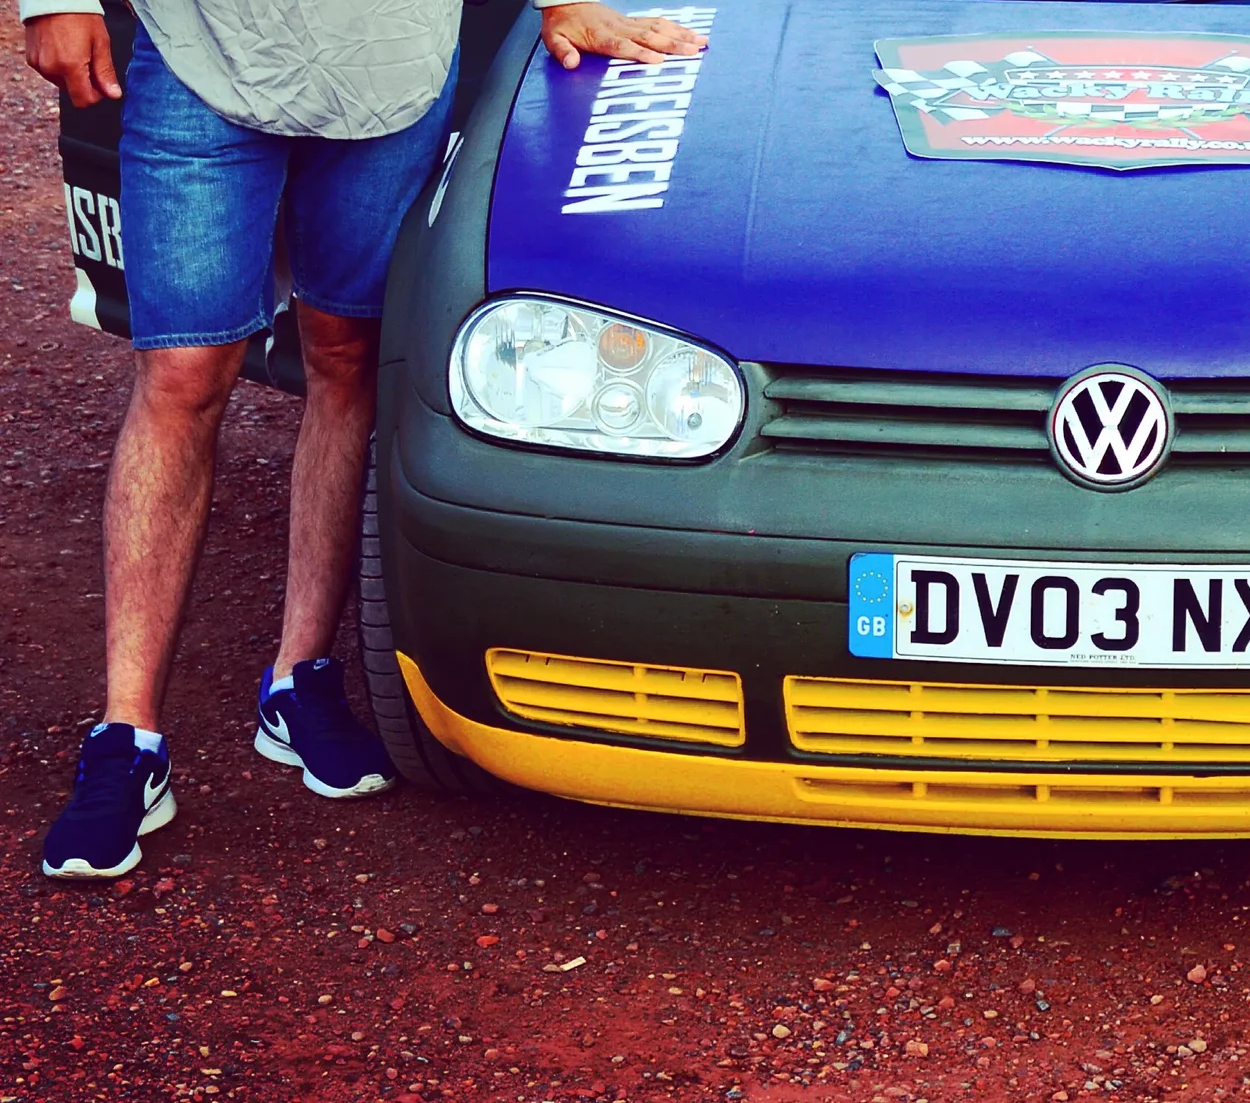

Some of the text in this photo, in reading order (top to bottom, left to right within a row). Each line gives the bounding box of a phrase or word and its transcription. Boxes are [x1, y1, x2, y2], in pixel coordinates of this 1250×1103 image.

[968, 79, 1130, 103] Wacky
[911, 570, 1141, 651] DV03
[857, 617, 886, 636] GB
